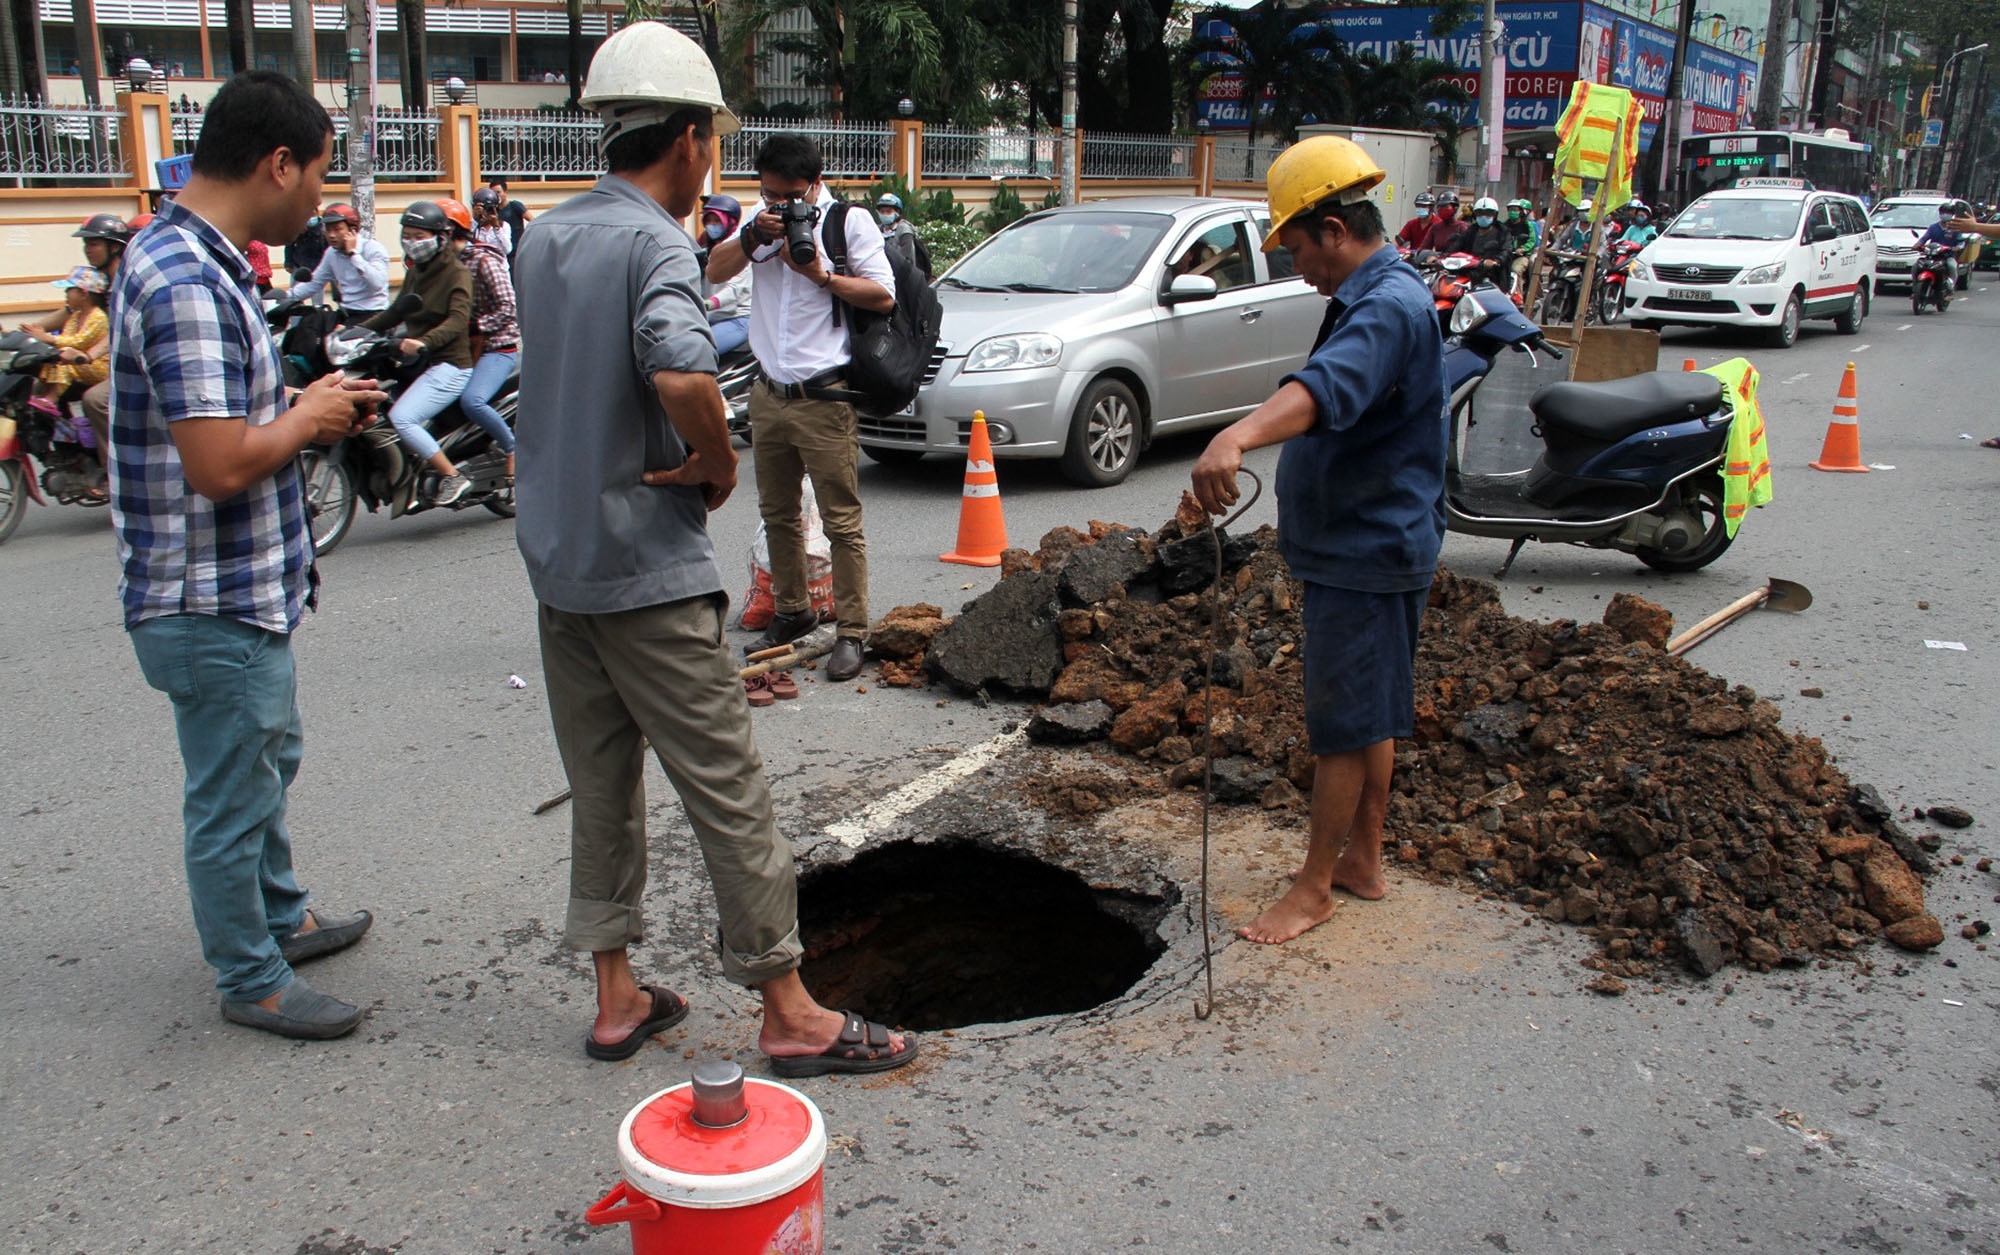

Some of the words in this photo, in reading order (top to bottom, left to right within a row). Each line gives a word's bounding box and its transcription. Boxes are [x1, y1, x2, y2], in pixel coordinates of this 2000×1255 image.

[1369, 17, 1382, 26] GIA
[1509, 31, 1552, 68] CỪ
[1727, 139, 1739, 152] 91
[1696, 157, 1712, 167] 91
[1755, 179, 1788, 187] VINASUN
